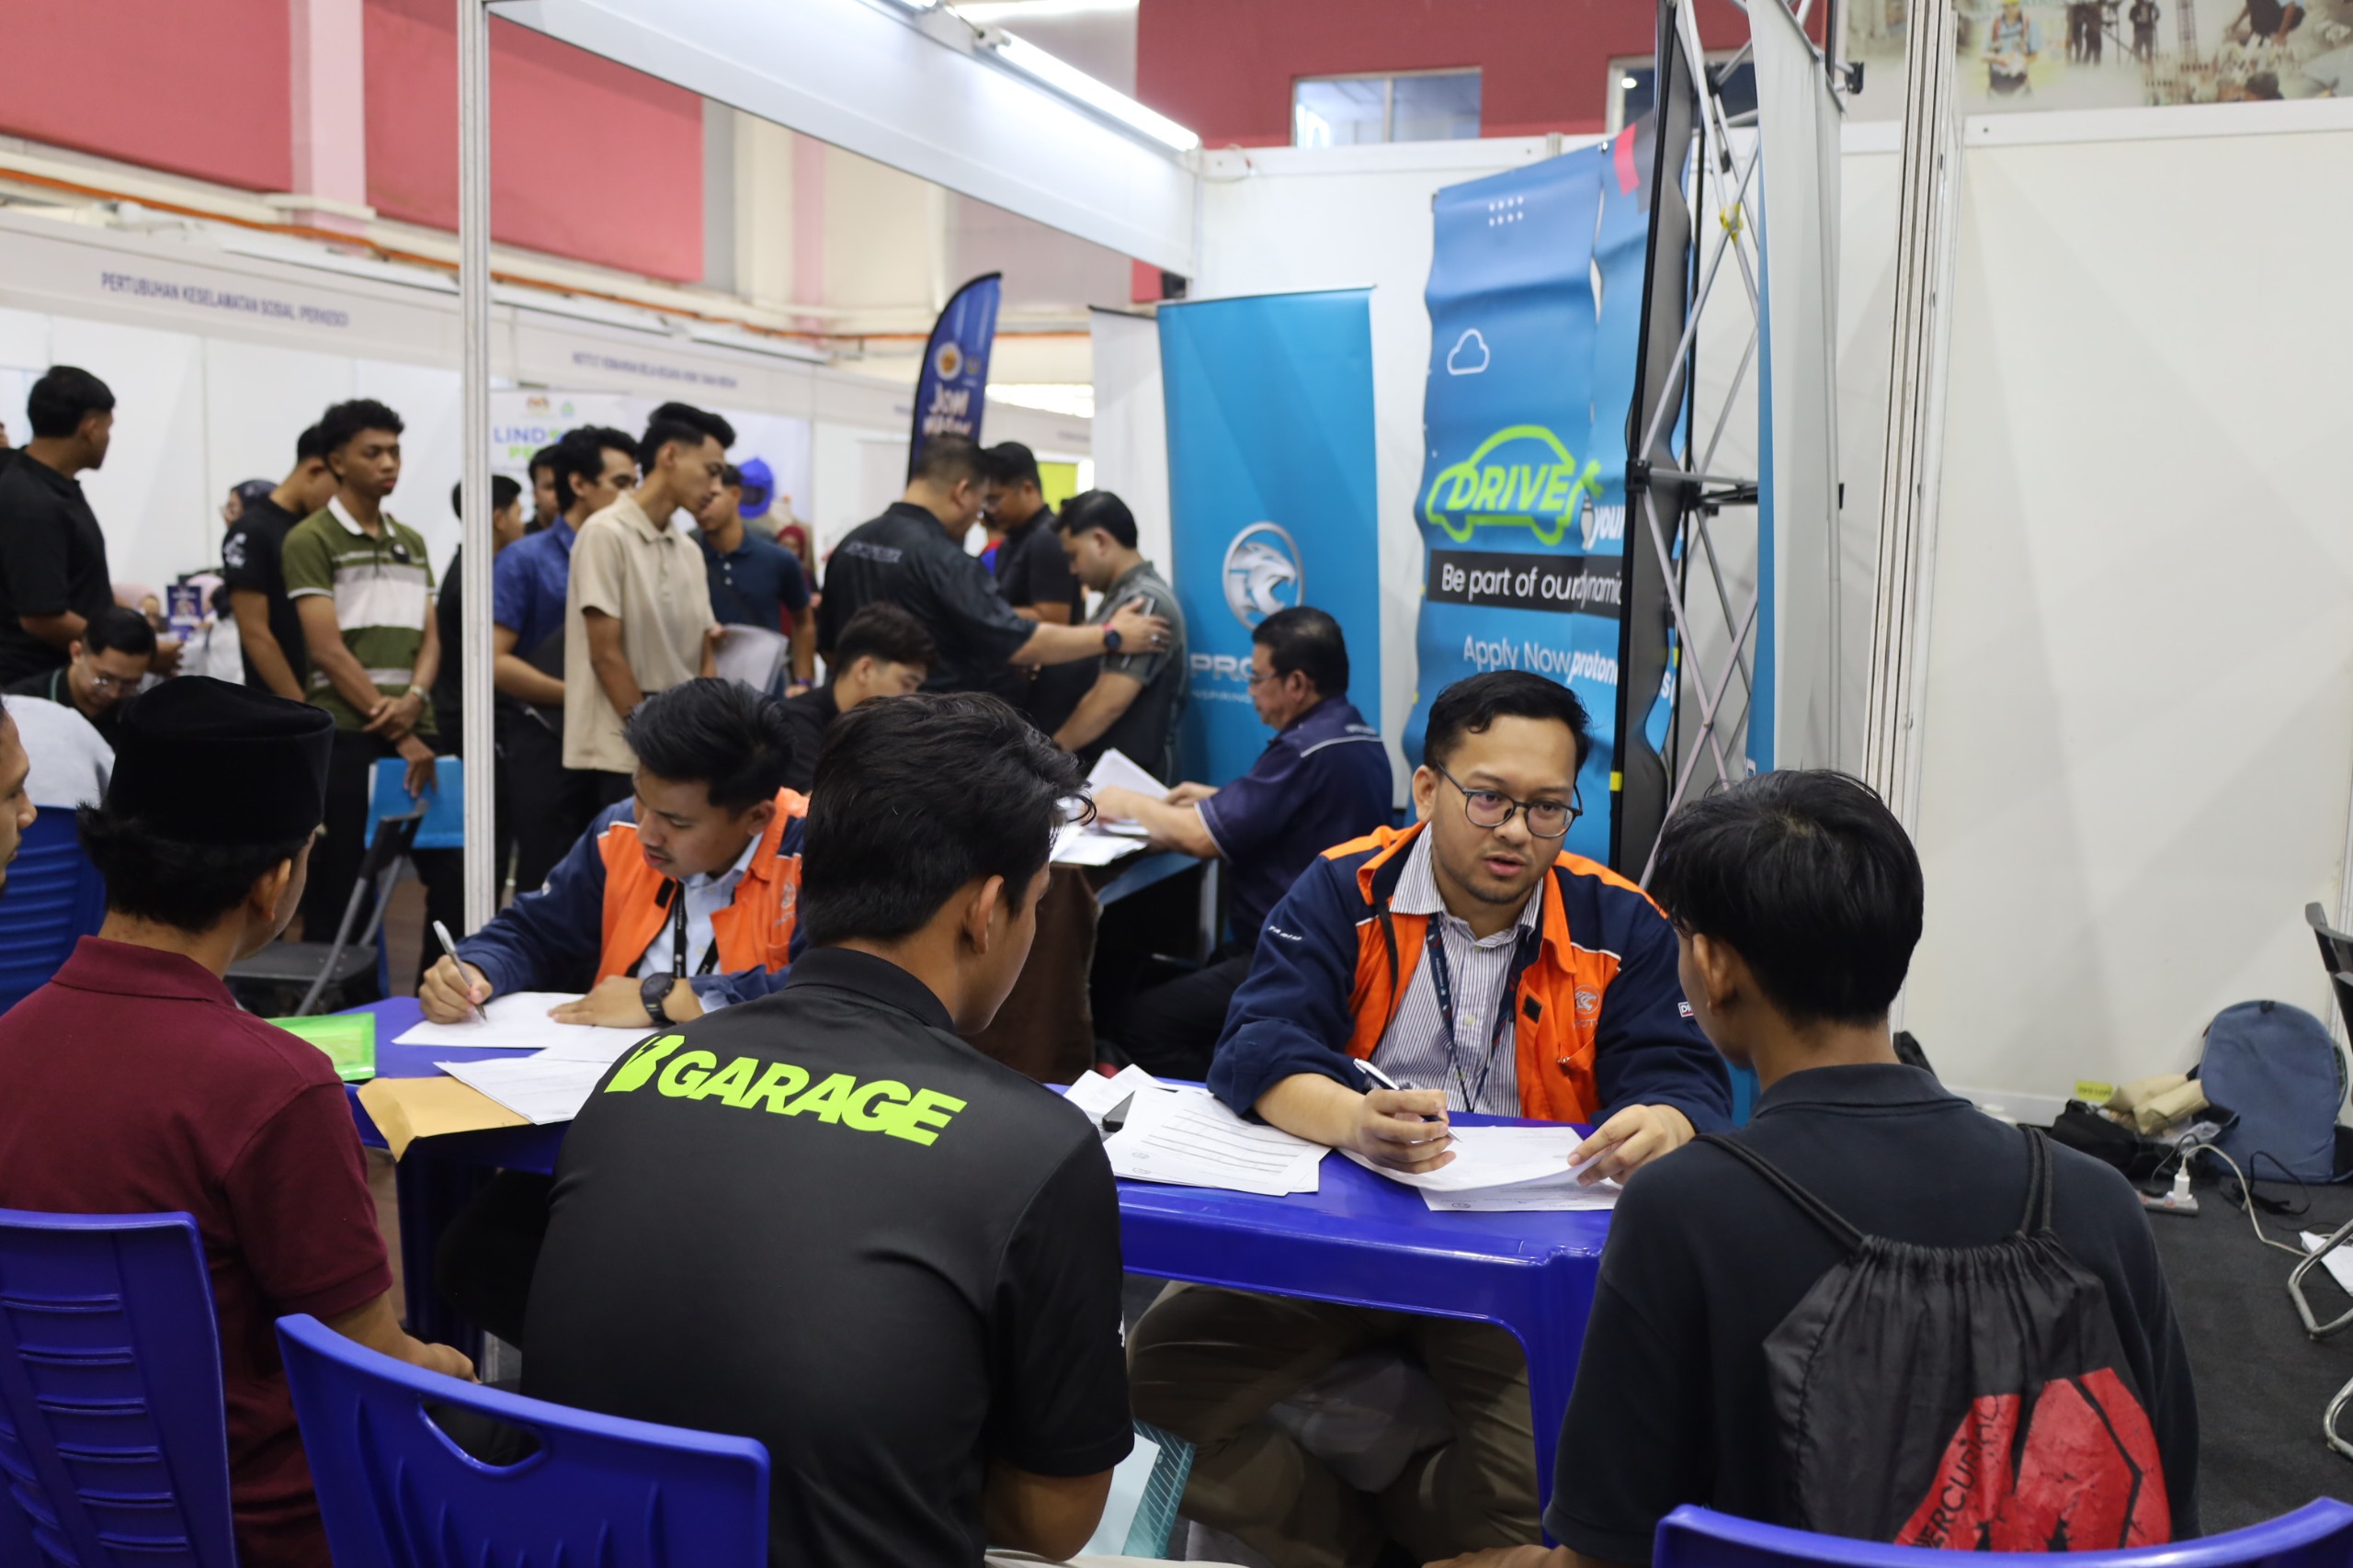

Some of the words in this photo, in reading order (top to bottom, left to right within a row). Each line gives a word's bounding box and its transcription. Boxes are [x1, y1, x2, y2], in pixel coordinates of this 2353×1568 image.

[1446, 464, 1574, 511] DRIVE
[1441, 562, 1466, 593] Be
[1468, 567, 1512, 602] part
[1515, 566, 1540, 597] of
[1540, 574, 1578, 601] our
[1463, 634, 1519, 673] Apply
[1524, 641, 1571, 675] Now
[656, 1050, 968, 1147] GARAGE
